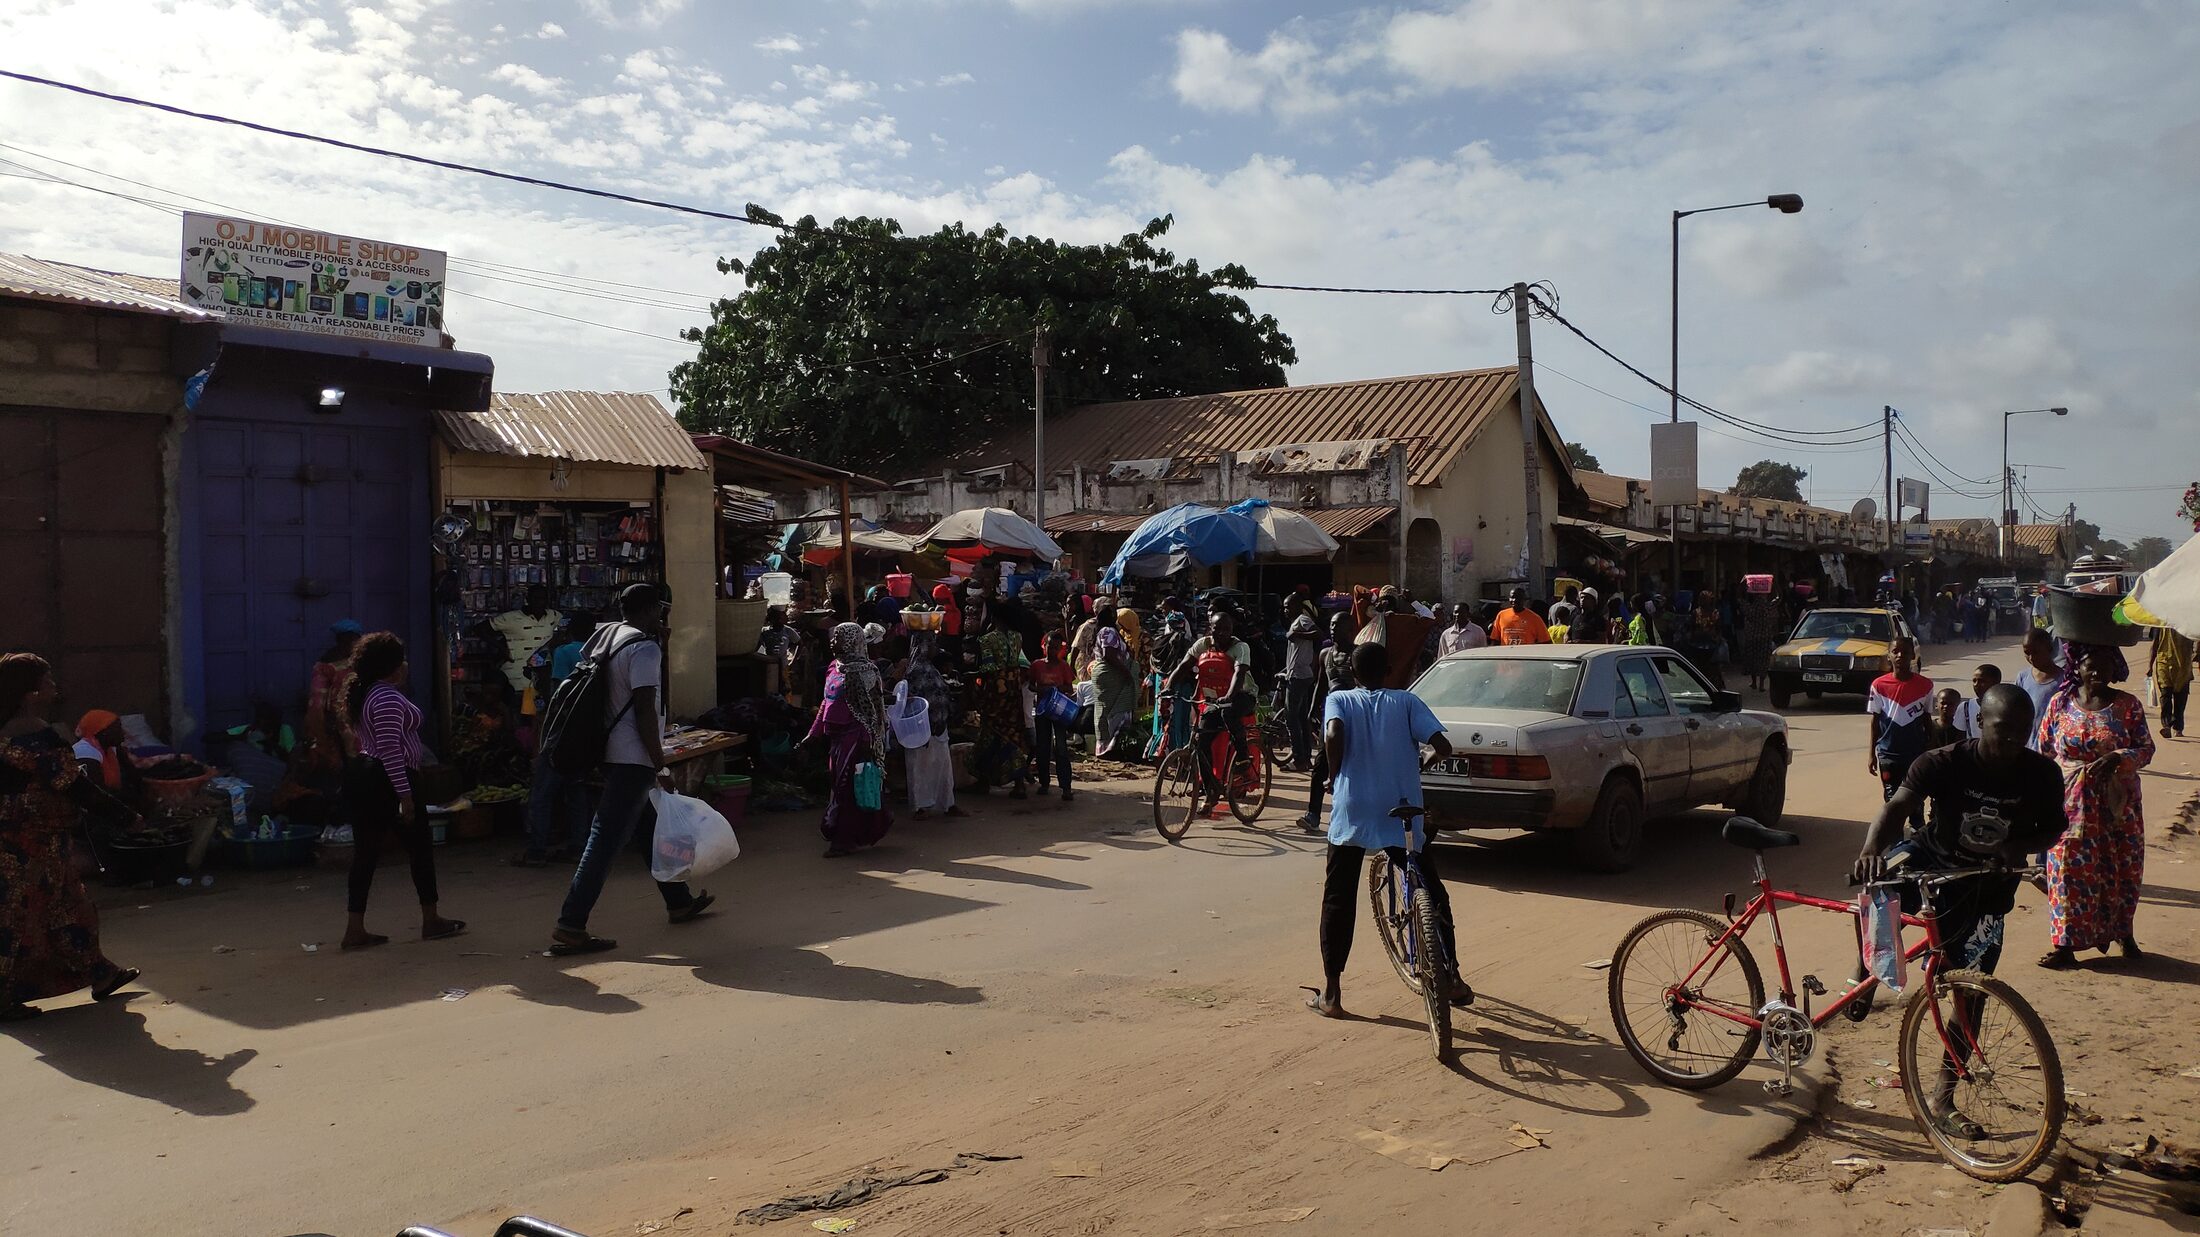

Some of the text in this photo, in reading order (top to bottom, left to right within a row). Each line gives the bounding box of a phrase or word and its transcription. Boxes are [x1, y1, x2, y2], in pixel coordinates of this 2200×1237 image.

[217, 220, 419, 265] O.J MOBILE SHOP
[199, 237, 224, 247] HIGH
[228, 241, 271, 254] QUALITY
[274, 247, 311, 260] MOBILE
[314, 254, 353, 266] PHONES
[356, 259, 363, 267] &
[365, 260, 430, 277] ACCESSORIES
[249, 254, 283, 266] TECNO
[266, 311, 272, 319] &
[276, 312, 309, 323] RETAIL
[326, 319, 390, 332] REASONABLE
[392, 325, 425, 337] PRICES
[1508, 638, 1522, 646] 737
[1427, 759, 1460, 773] 215 K
